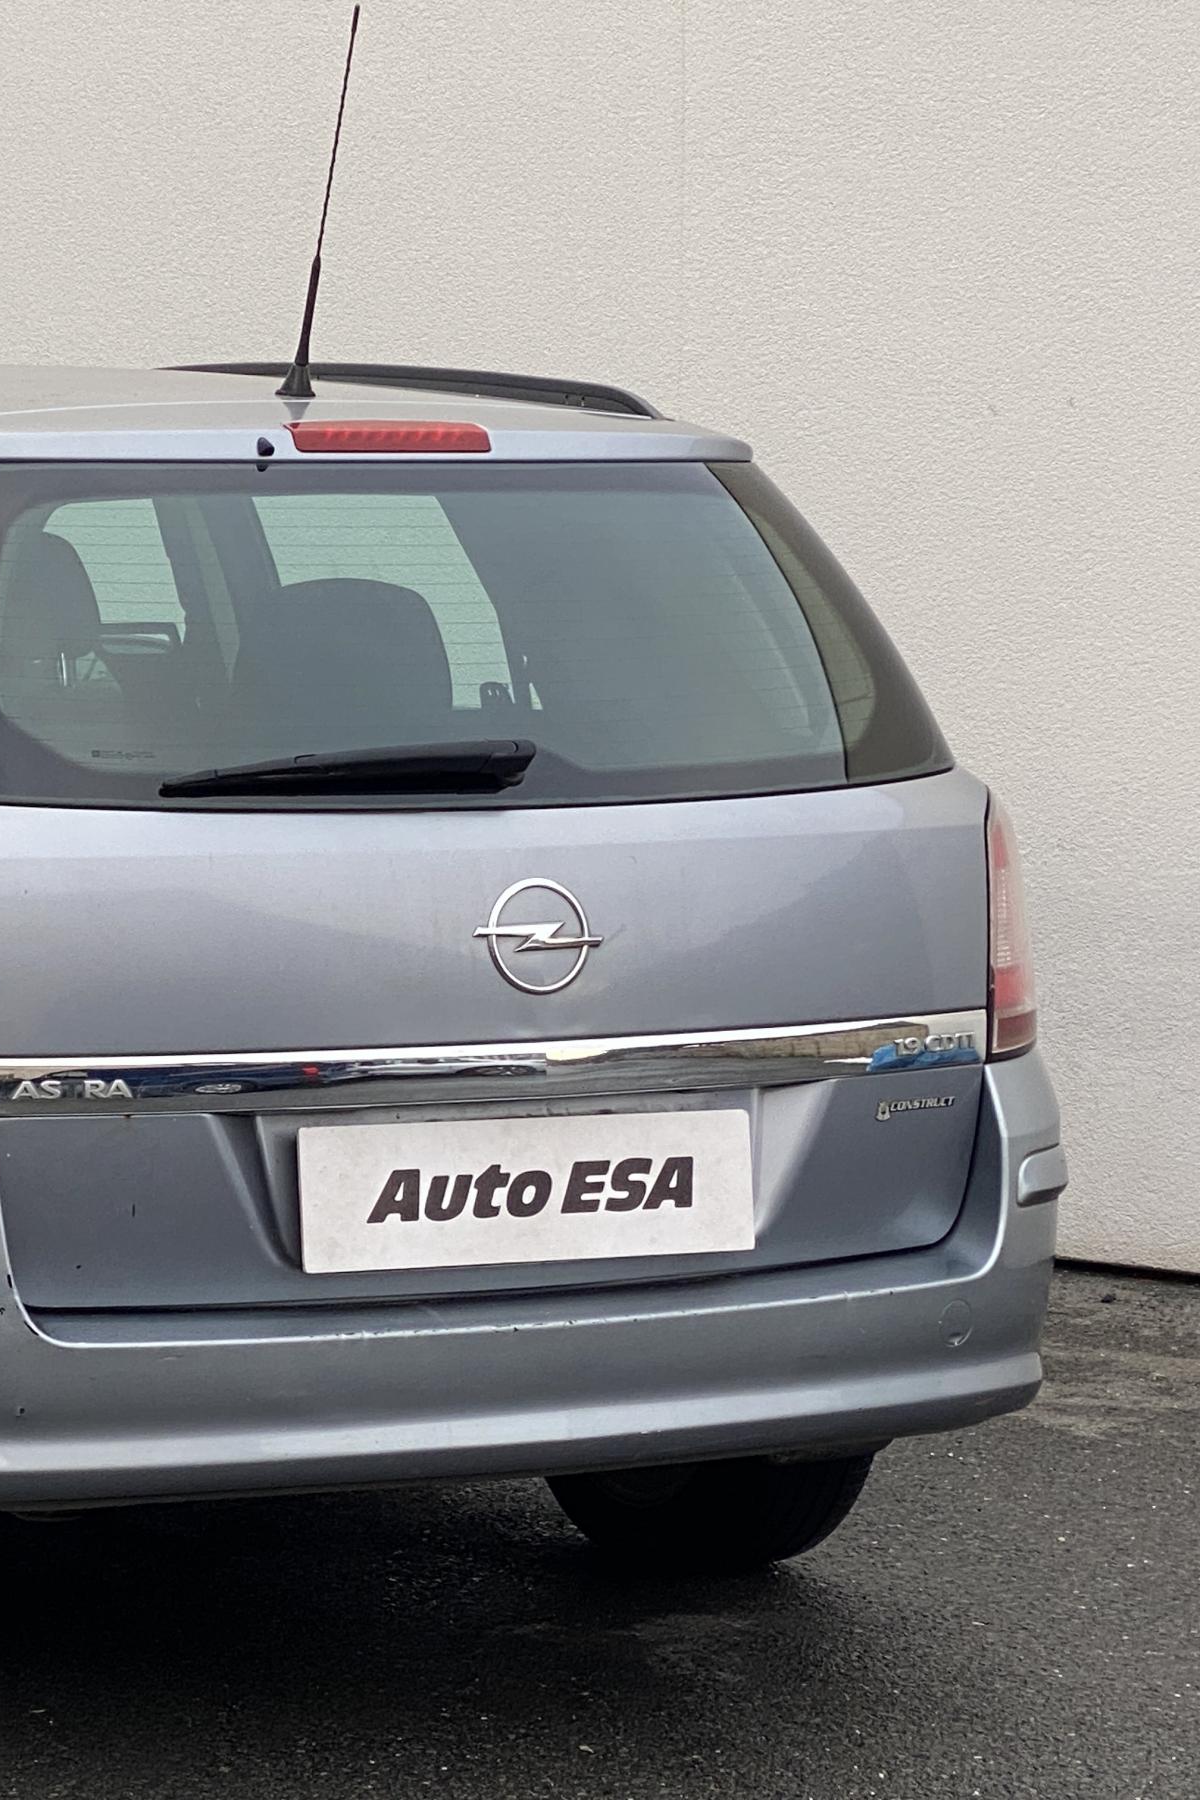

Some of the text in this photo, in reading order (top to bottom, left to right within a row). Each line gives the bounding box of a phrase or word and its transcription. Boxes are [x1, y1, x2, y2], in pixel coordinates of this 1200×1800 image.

[925, 1032, 975, 1052] CDTI
[11, 1079, 133, 1099] ASTRA
[890, 1096, 955, 1112] CONSTRUCT
[366, 1156, 694, 1224] Auto ESA
